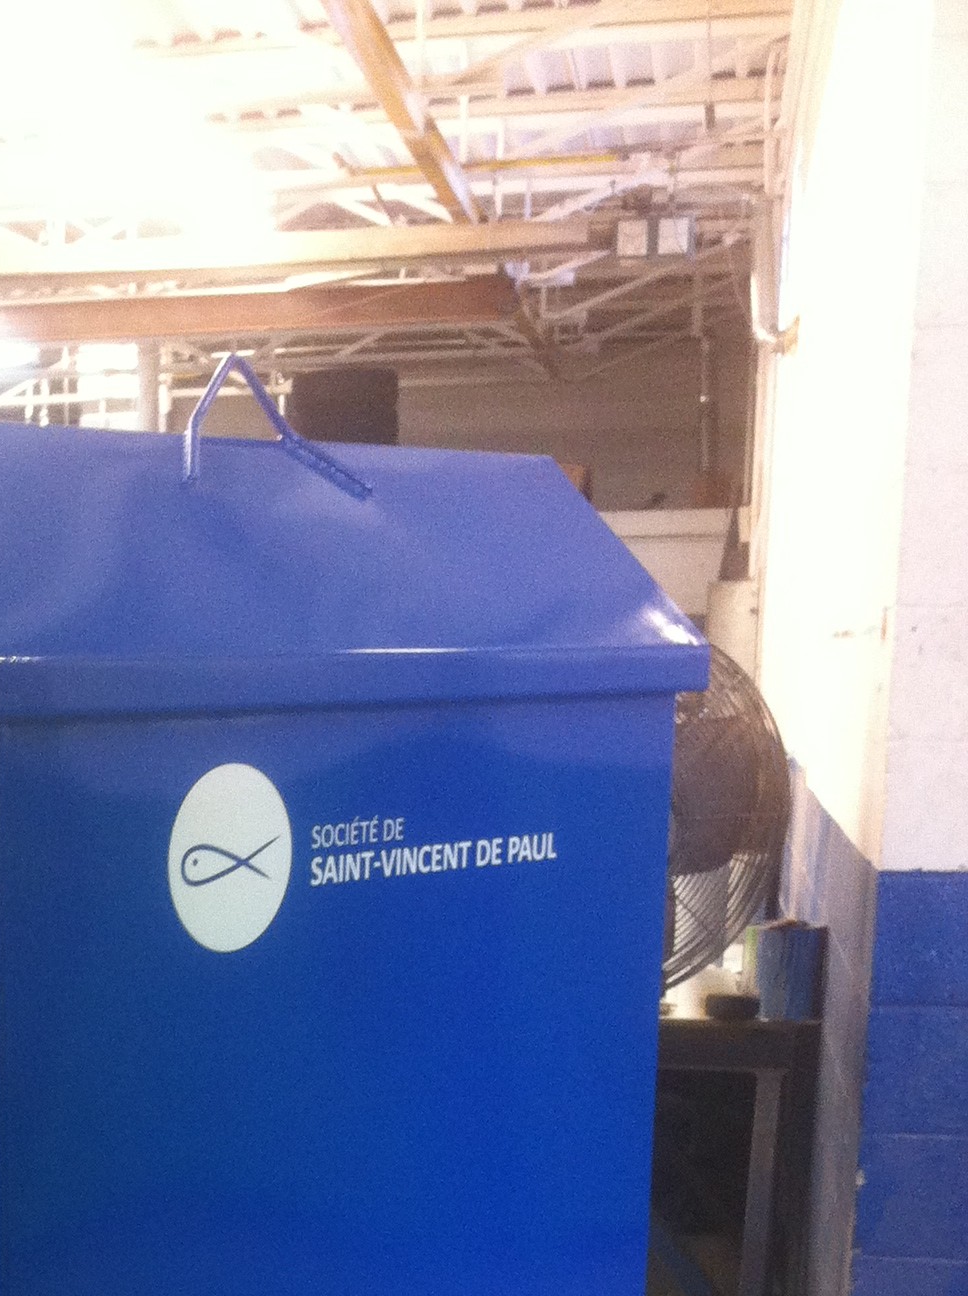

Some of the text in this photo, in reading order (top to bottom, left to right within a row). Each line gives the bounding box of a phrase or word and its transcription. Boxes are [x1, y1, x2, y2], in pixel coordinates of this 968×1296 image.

[311, 815, 404, 849] SOCIÉTÉ DE
[310, 832, 557, 886] SAINT-VINCENT DE PAUL
